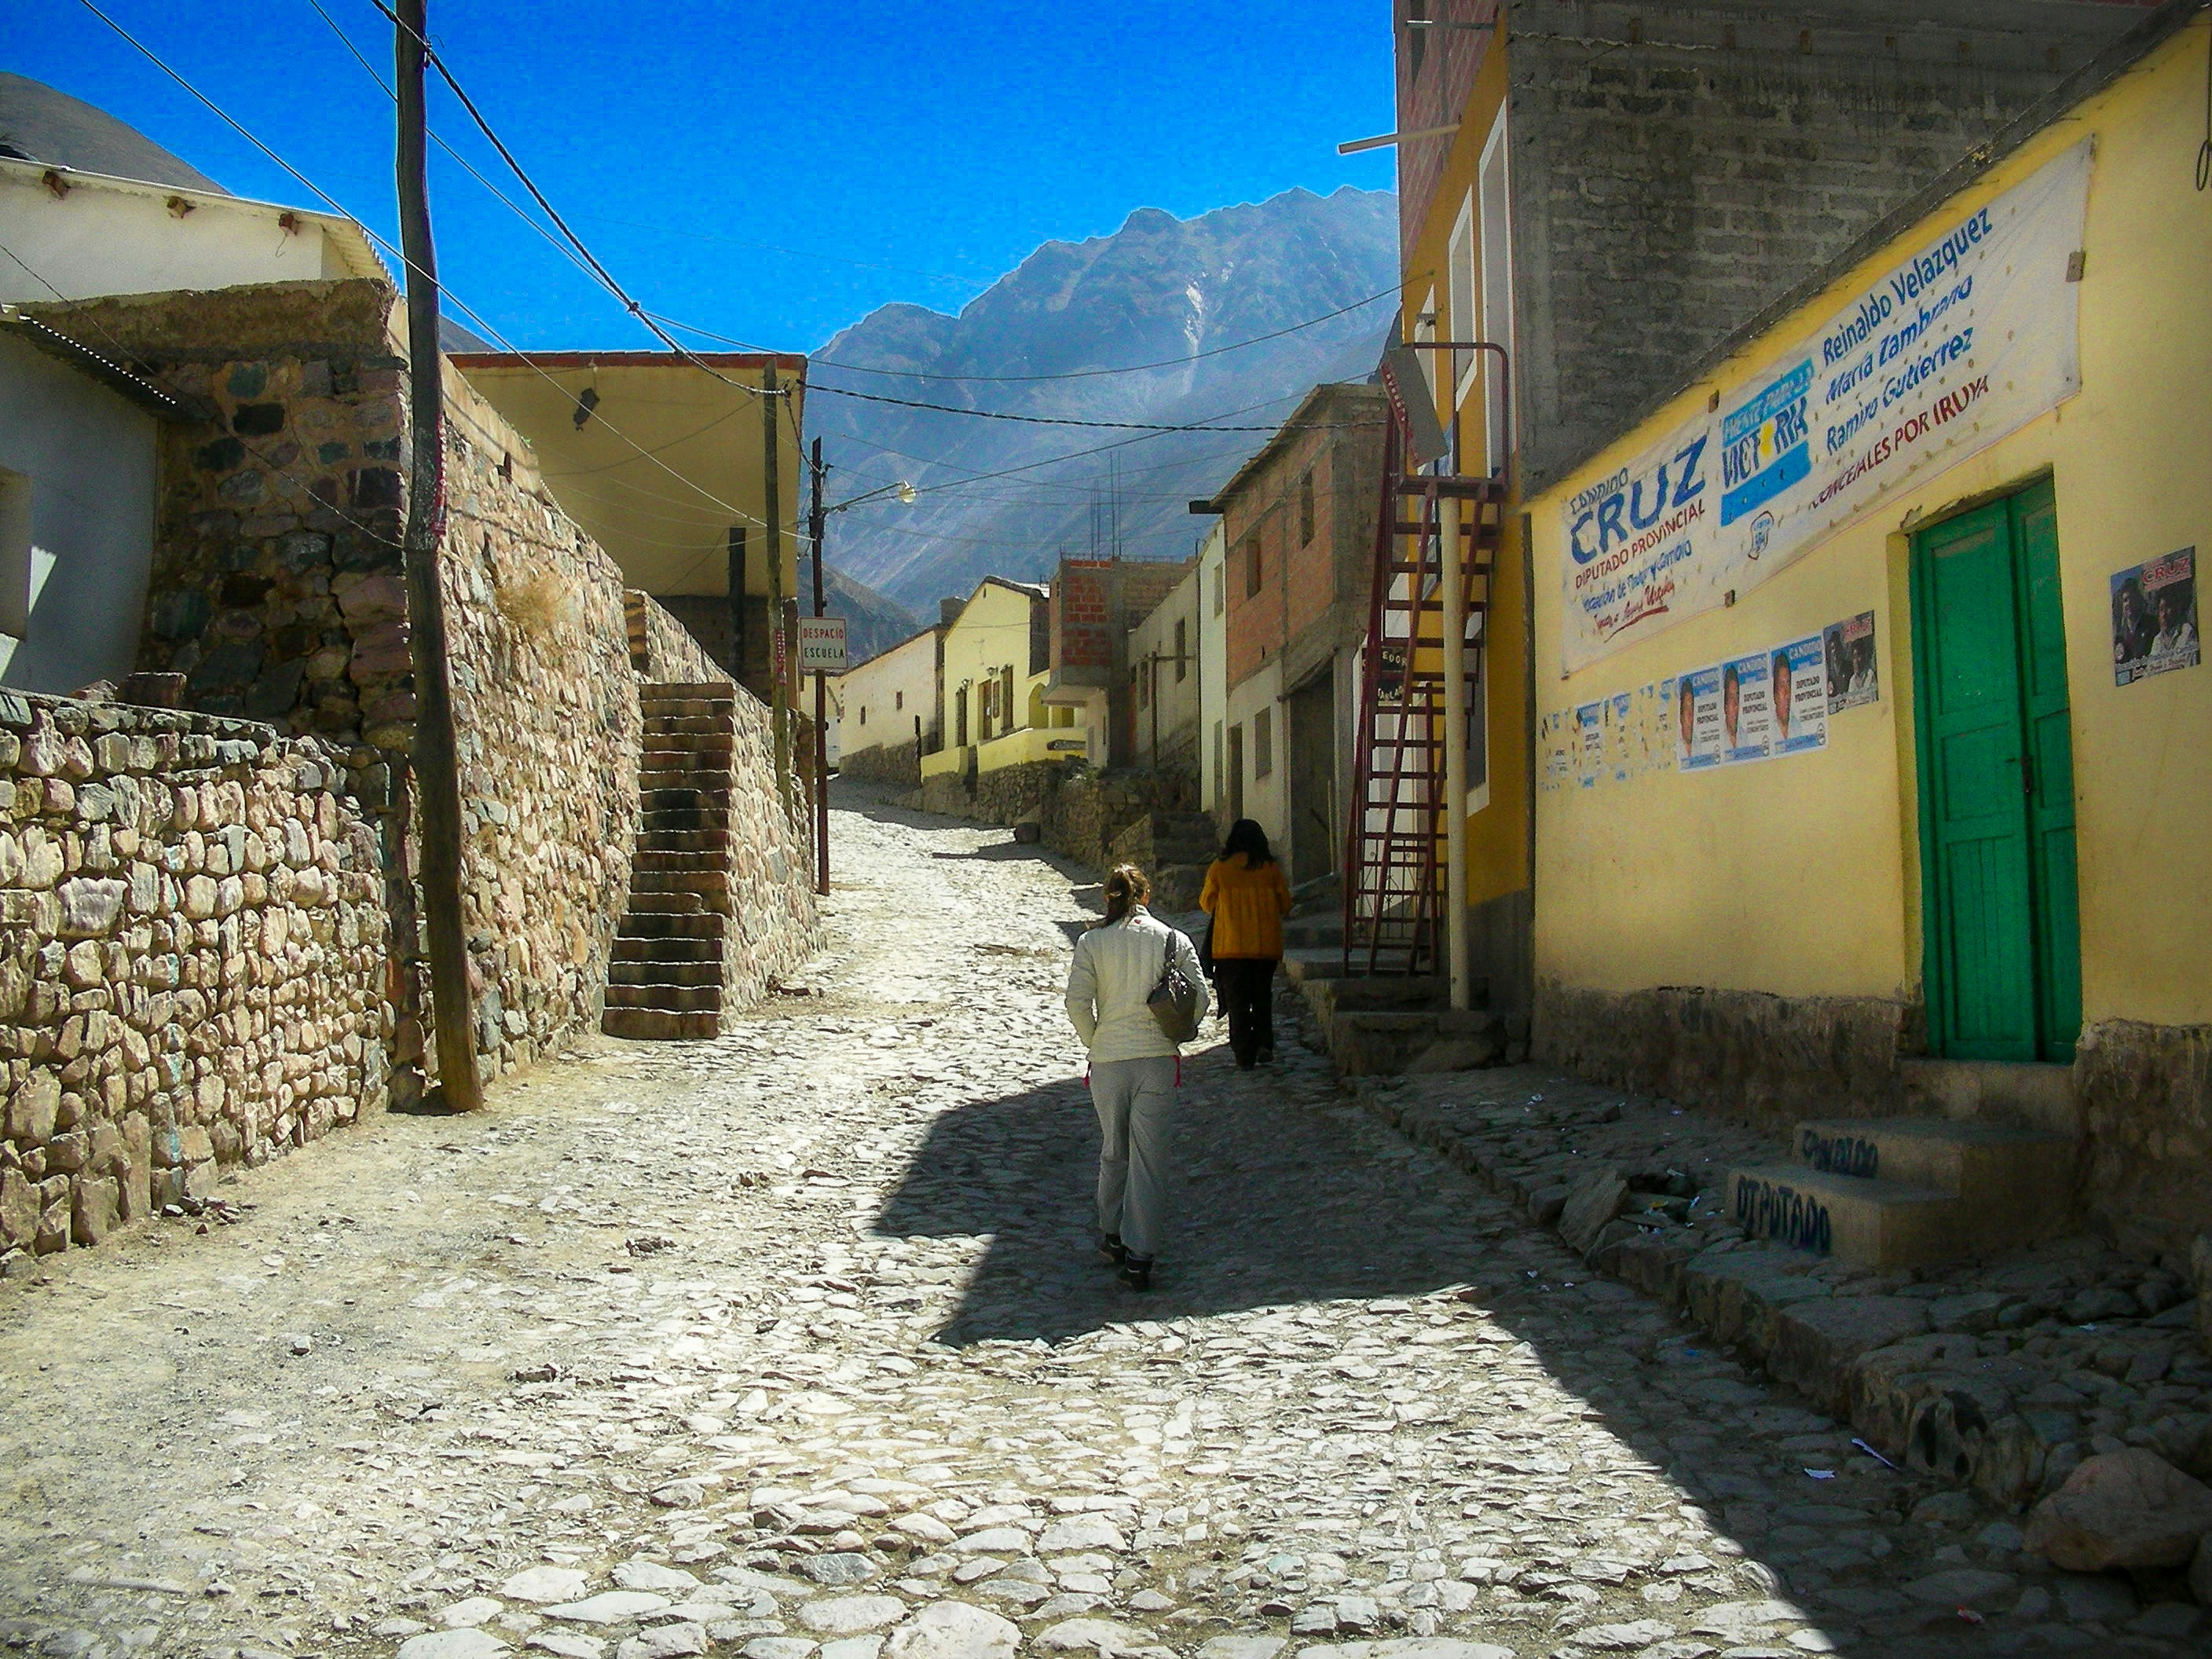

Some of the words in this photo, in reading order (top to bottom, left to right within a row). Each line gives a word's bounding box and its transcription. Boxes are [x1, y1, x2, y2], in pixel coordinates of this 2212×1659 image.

[1822, 293, 1892, 368] Reinaldo
[1890, 207, 1993, 306] Velazquez
[1879, 275, 1973, 368] Zambrano
[1826, 396, 1878, 456] Ramiro
[1895, 411, 1931, 452] POR
[1933, 375, 1989, 426] IRUYA
[1570, 434, 1707, 565] CRUZ
[1575, 548, 1629, 590] DIPUTADO
[1631, 498, 1705, 558] PROVINCIAL
[2142, 556, 2190, 584] CRUZ
[803, 628, 844, 639] DESPACIO
[804, 646, 845, 658] ESCUELA
